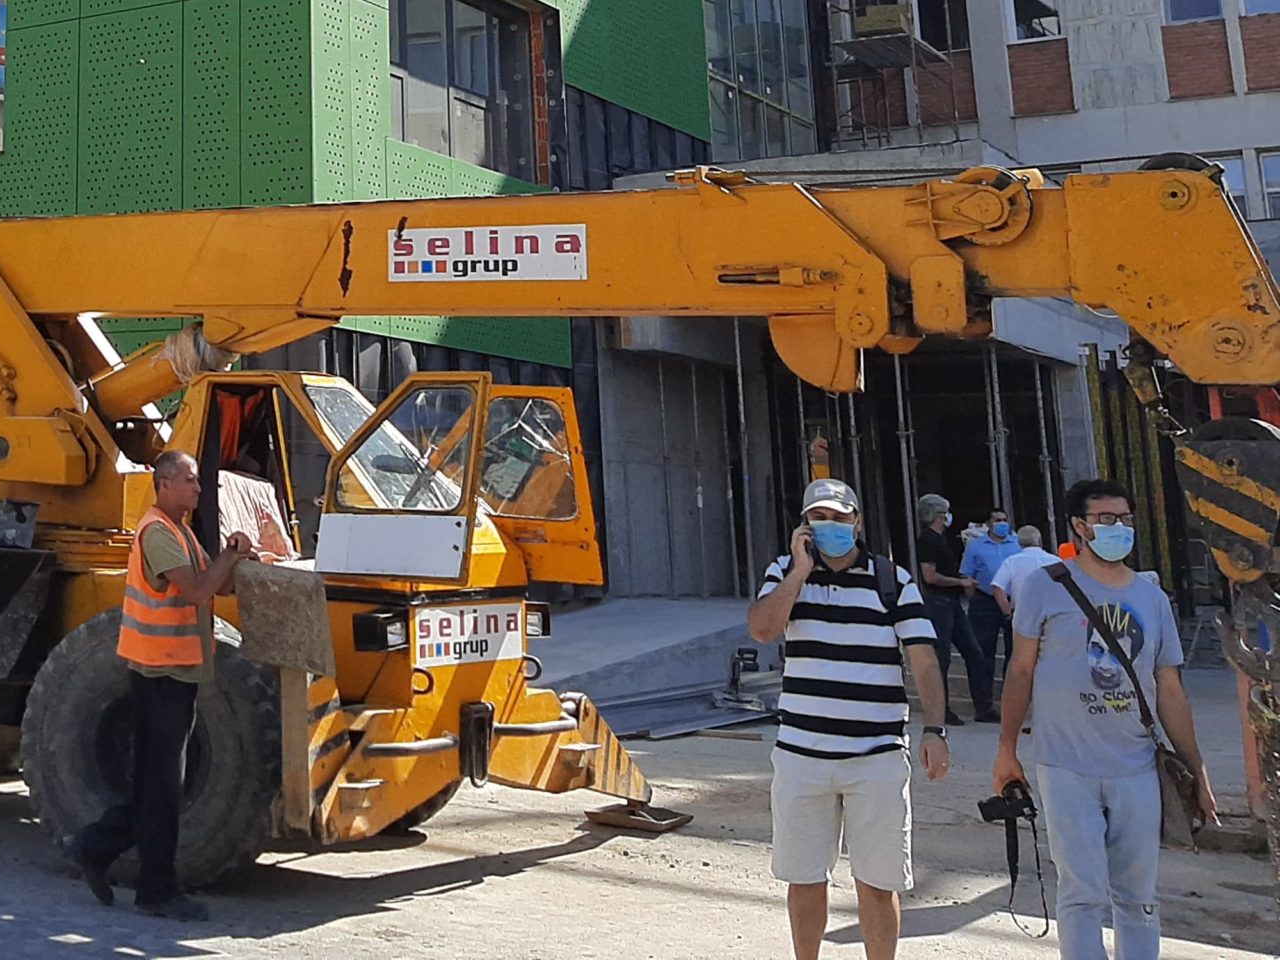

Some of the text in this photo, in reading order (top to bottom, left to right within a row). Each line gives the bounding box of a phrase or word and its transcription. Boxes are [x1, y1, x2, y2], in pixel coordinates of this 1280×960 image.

[393, 230, 581, 256] selina
[452, 259, 518, 277] grup
[419, 609, 518, 639] selina
[454, 639, 488, 660] grup
